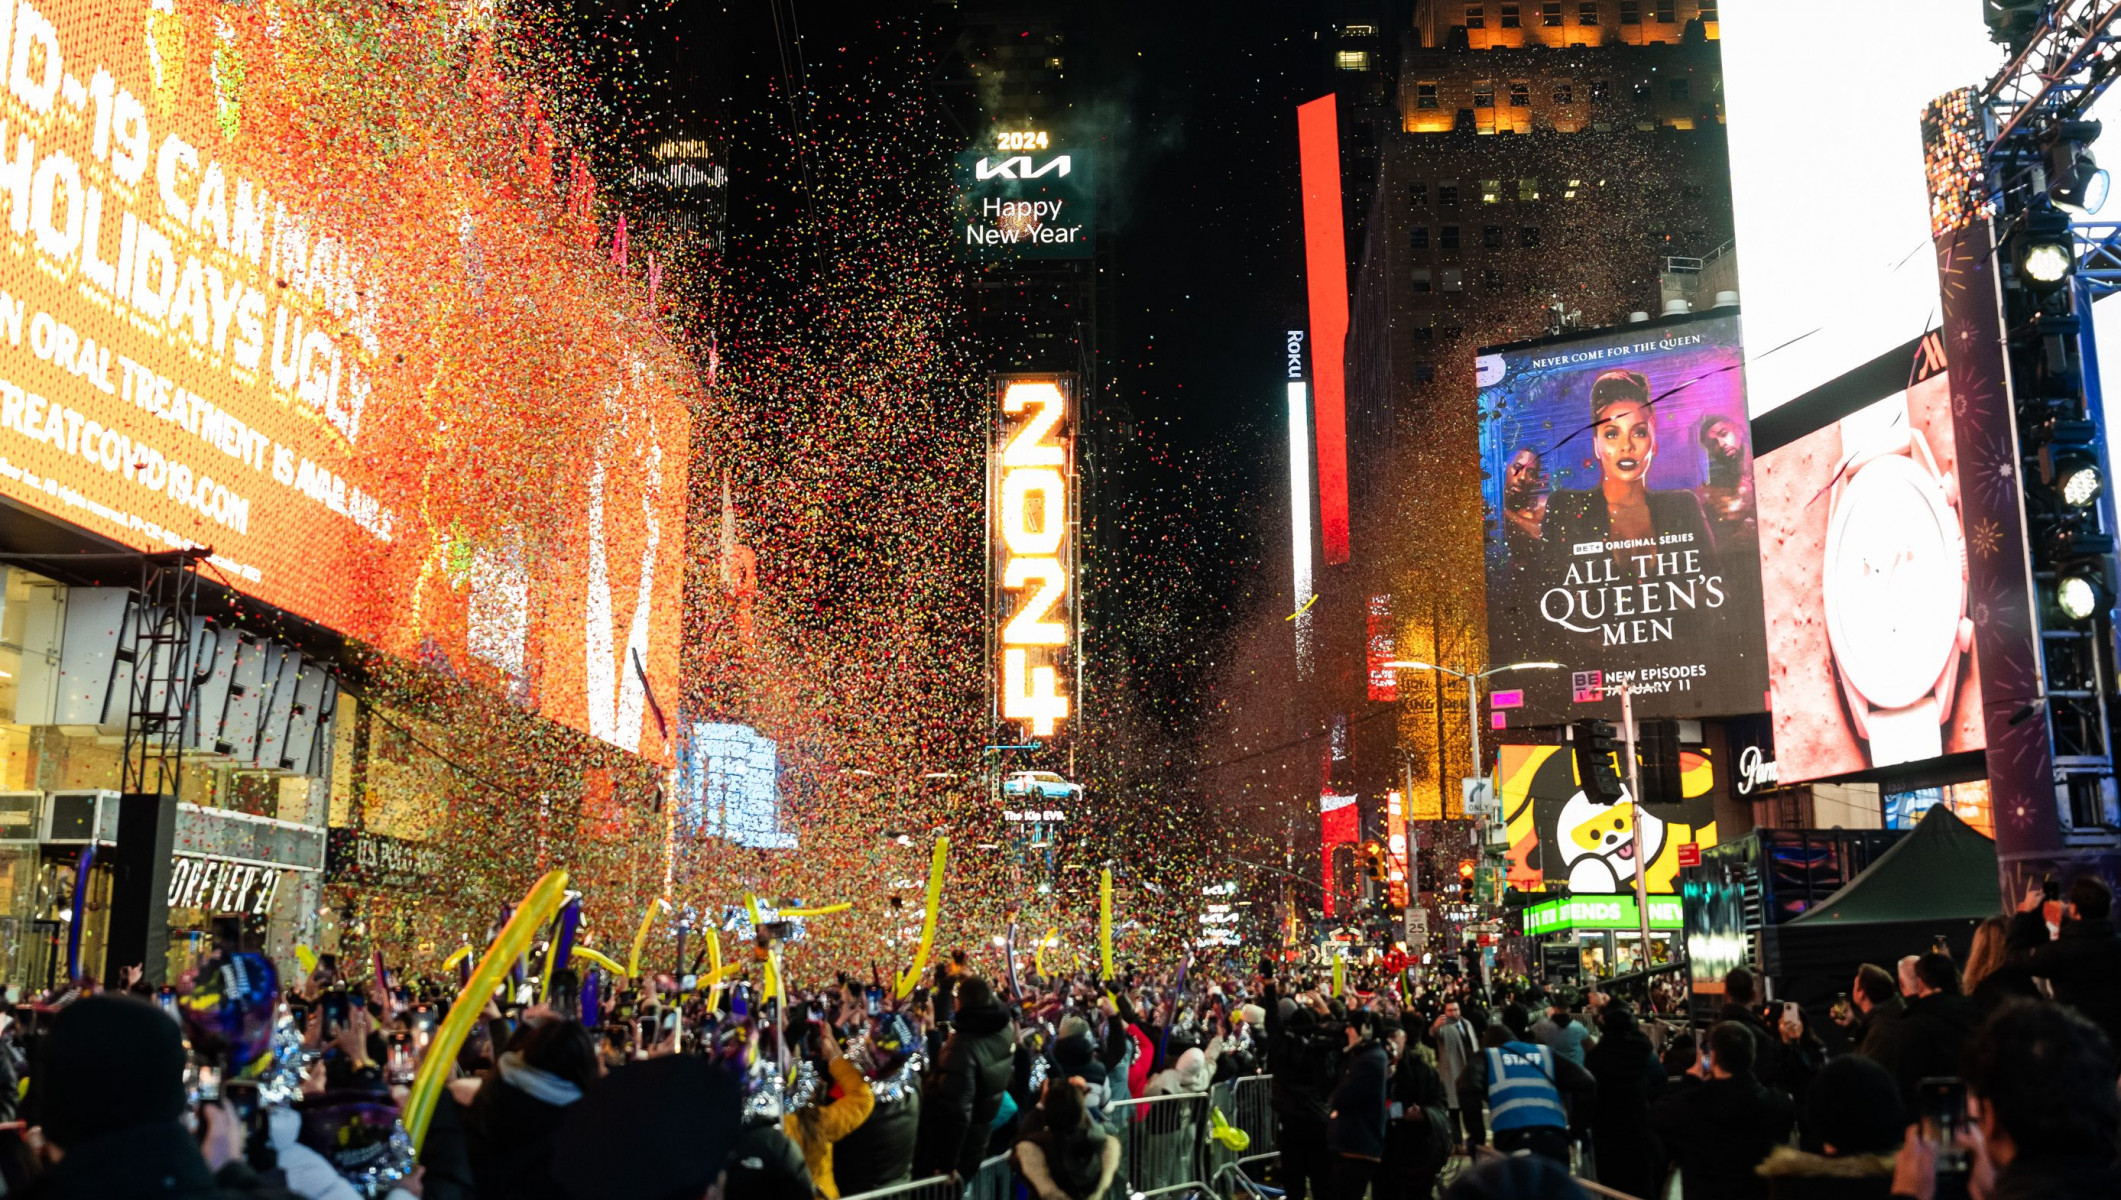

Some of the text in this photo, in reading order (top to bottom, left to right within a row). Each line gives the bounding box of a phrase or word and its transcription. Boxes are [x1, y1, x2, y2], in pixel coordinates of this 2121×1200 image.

[998, 132, 1048, 150] 2024
[157, 133, 271, 265] CAN
[983, 198, 1063, 221] Happy
[967, 223, 1079, 245] New Year
[1287, 330, 1304, 378] Roku
[1532, 334, 1701, 369] NEVER COME FOR THE QUEEN
[30, 312, 115, 395] ORAL
[118, 355, 269, 471] TREATMENT
[272, 442, 294, 487] IS
[1605, 537, 1657, 550] ORIGINAL
[1659, 532, 1695, 545] SERIES
[1001, 382, 1069, 737] 2024
[1563, 549, 1701, 586] ALL THE
[1540, 575, 1725, 633] QUEEN'S
[1602, 617, 1674, 646] MEN
[1605, 664, 1707, 683] NEW EPISODES
[1678, 679, 1691, 691] 11
[1003, 810, 1023, 821] The
[1024, 810, 1041, 821] Kia
[1468, 804, 1489, 812] ONLY
[168, 857, 282, 915] OREVER 21
[1408, 923, 1425, 934] 25
[1502, 1052, 1542, 1066] STAFF
